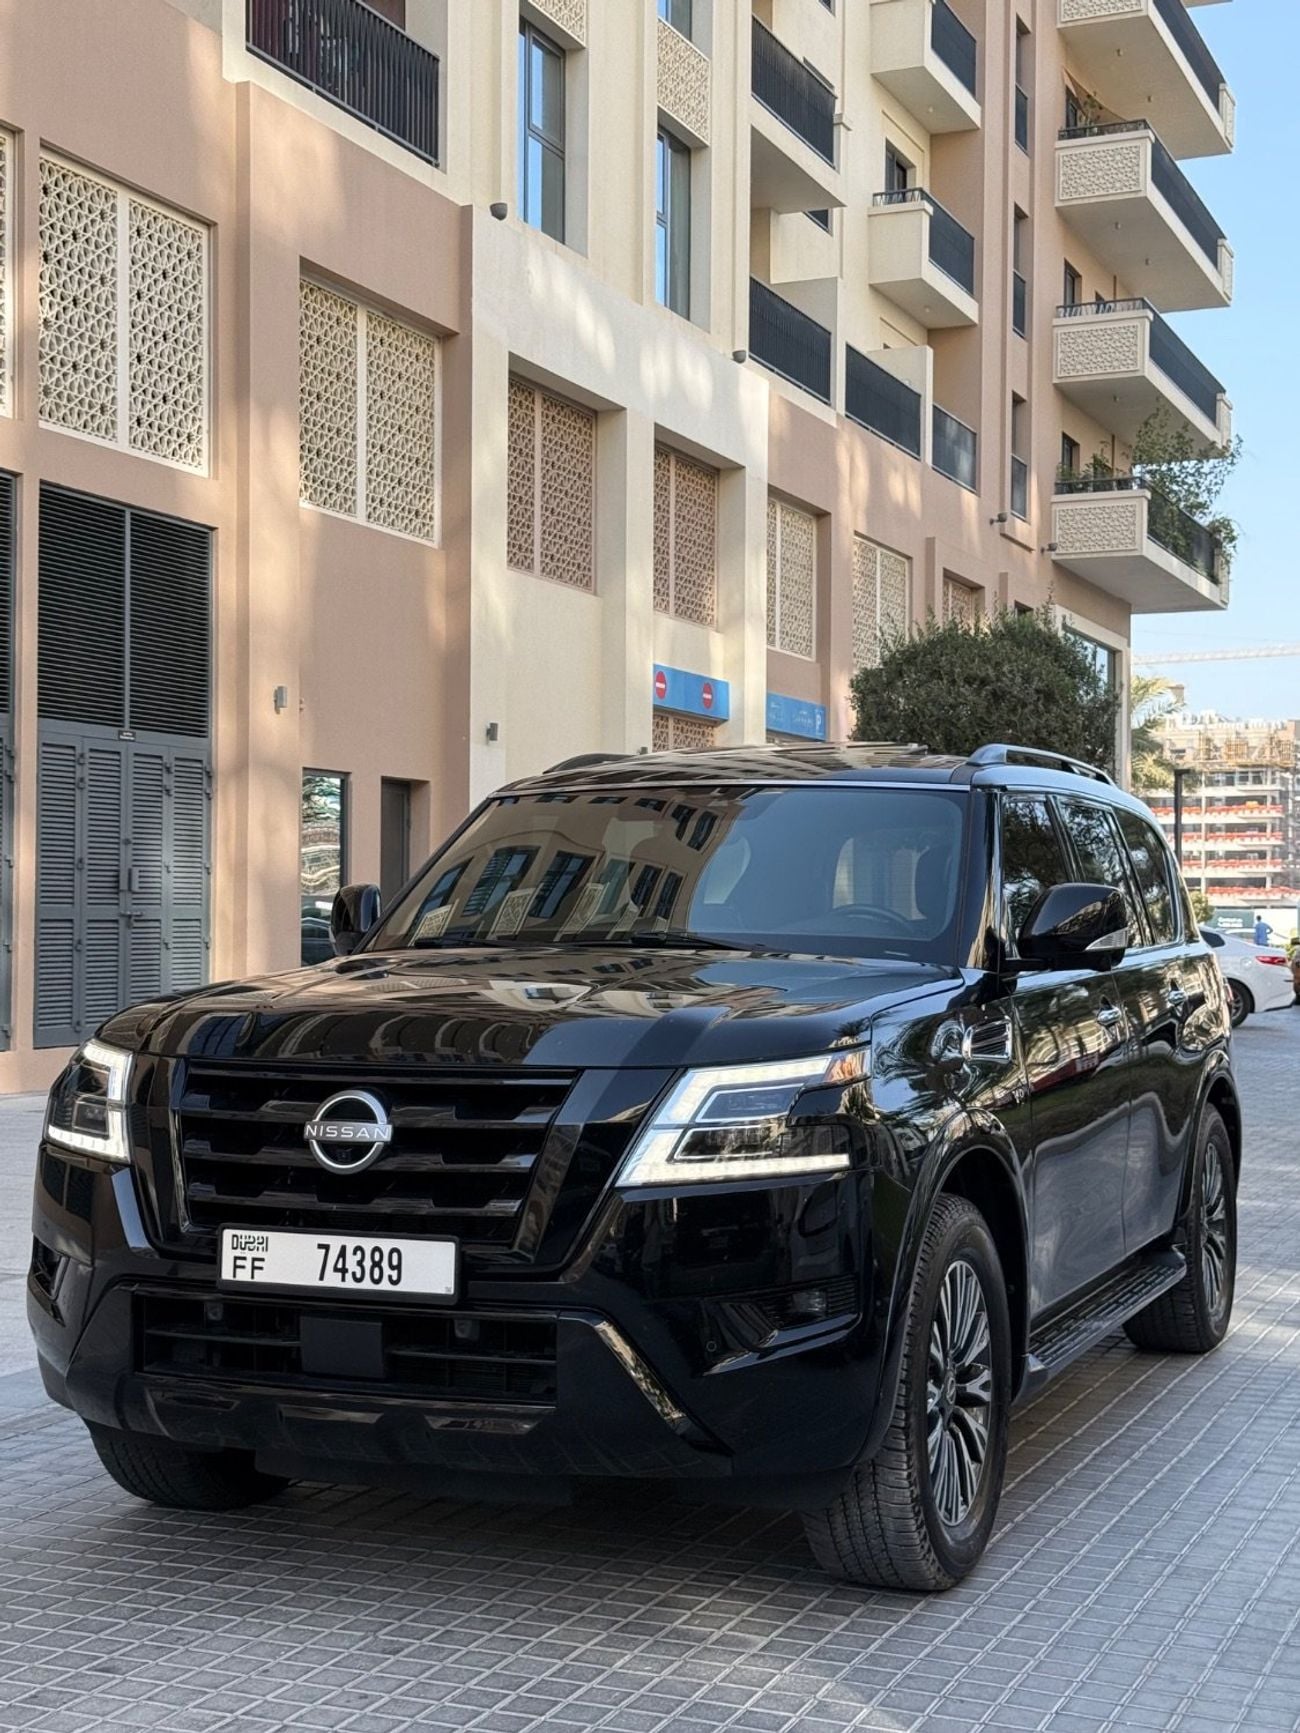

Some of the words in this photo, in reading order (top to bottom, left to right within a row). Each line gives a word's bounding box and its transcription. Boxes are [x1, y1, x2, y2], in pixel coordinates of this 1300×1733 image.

[305, 1124, 389, 1139] NISSAN
[232, 1255, 266, 1280] FF
[316, 1243, 403, 1286] 74389
